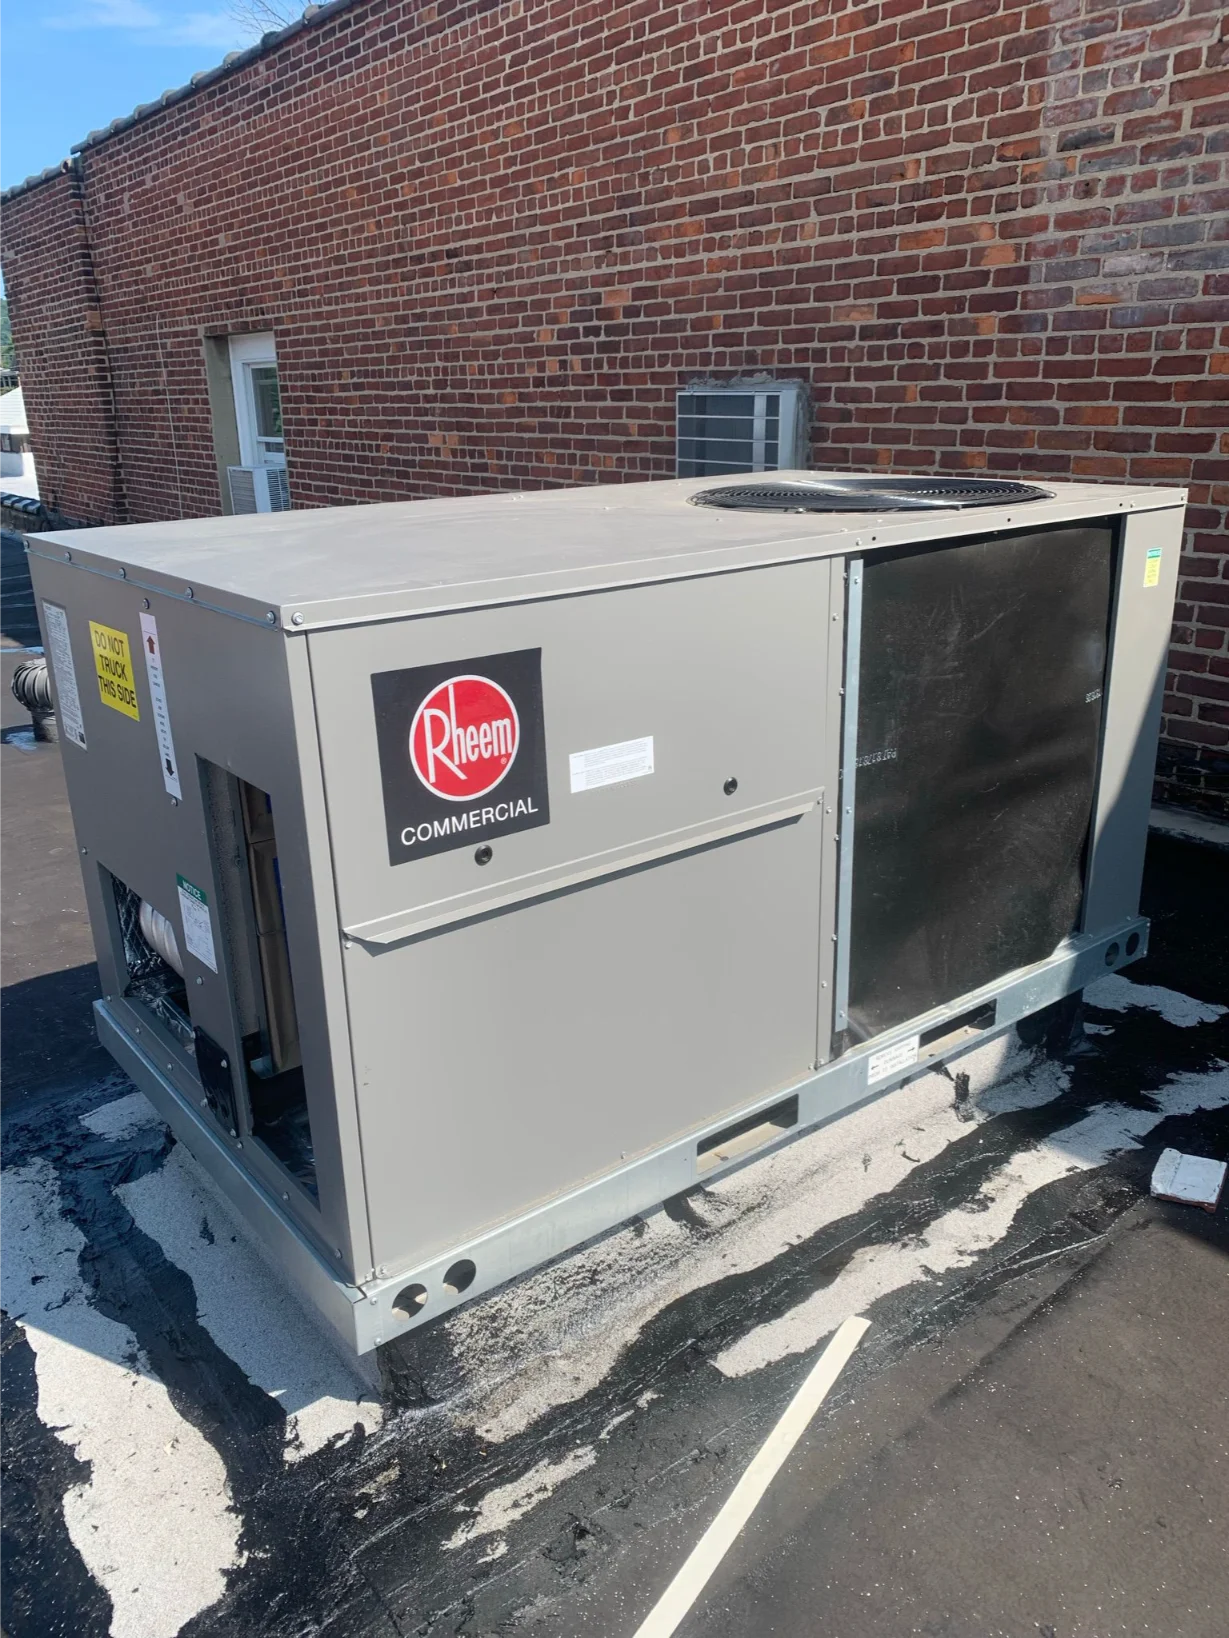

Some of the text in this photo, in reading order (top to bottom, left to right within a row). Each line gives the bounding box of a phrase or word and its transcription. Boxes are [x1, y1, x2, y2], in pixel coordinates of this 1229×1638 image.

[94, 630, 124, 657] DO NOT
[99, 654, 128, 681] TRUCK
[98, 675, 137, 708] THIS SIDE
[423, 684, 512, 784] Rheem
[400, 796, 538, 846] COMMERCIAL
[182, 880, 202, 901] NOTICE
